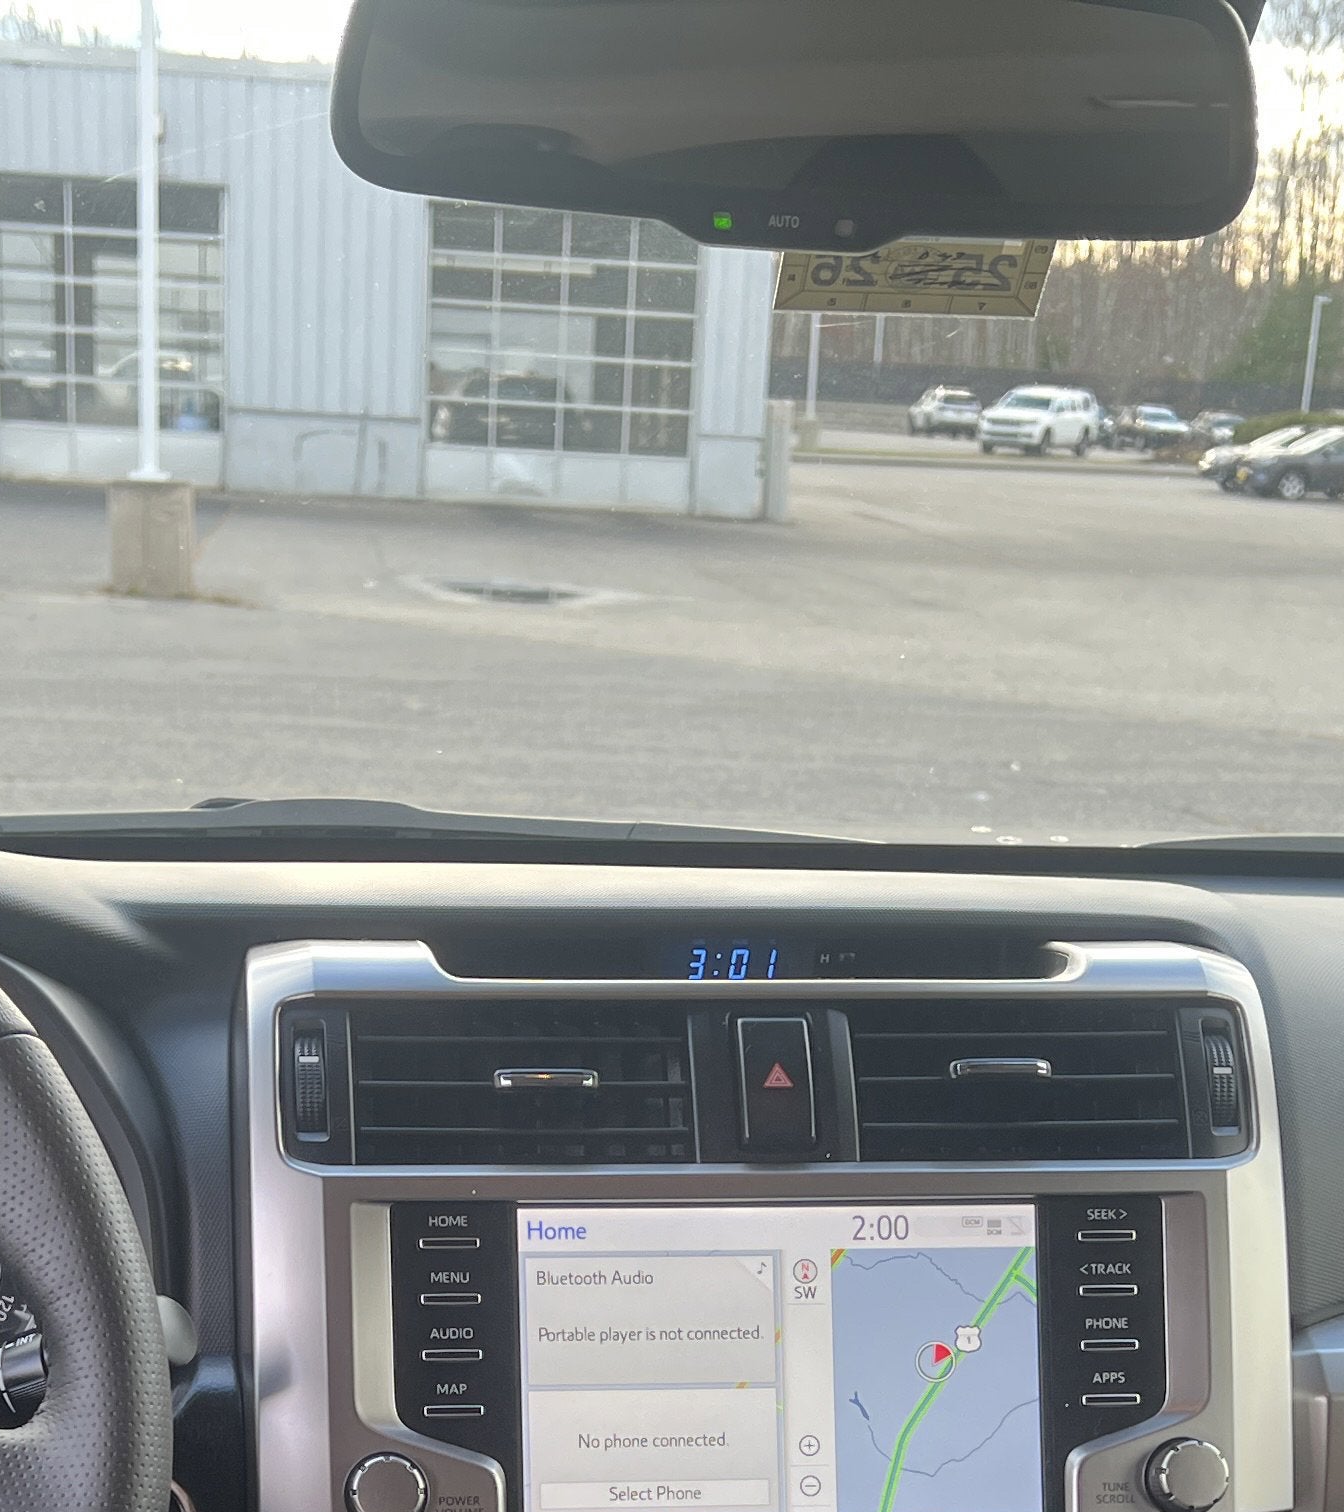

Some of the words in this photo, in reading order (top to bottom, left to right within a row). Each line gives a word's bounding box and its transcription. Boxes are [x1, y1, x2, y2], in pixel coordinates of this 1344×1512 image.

[768, 215, 800, 229] AUTO
[688, 948, 778, 980] 3:01
[428, 1215, 468, 1228] HOME
[851, 1215, 910, 1241] 2:00
[527, 1221, 587, 1241] Home
[430, 1271, 470, 1284] MENU
[536, 1270, 607, 1286] Bluetooth
[611, 1269, 654, 1286] Audio
[794, 1287, 817, 1300] SW
[1085, 1317, 1129, 1330] PHONE
[430, 1327, 474, 1340] AUDIO
[538, 1327, 595, 1342] Portable
[599, 1327, 642, 1344] player
[645, 1327, 657, 1341] is
[659, 1327, 683, 1341] not
[687, 1326, 765, 1341] connected.
[1092, 1371, 1126, 1384] APPS
[436, 1383, 468, 1396] MAP
[578, 1434, 600, 1449] No
[604, 1433, 648, 1451] phone
[652, 1431, 730, 1448] connected.
[609, 1486, 653, 1501] Select
[657, 1485, 702, 1500] Phone
[1102, 1482, 1130, 1492] TUNE
[438, 1495, 480, 1506] POWER
[1096, 1494, 1136, 1504] SCROLL
